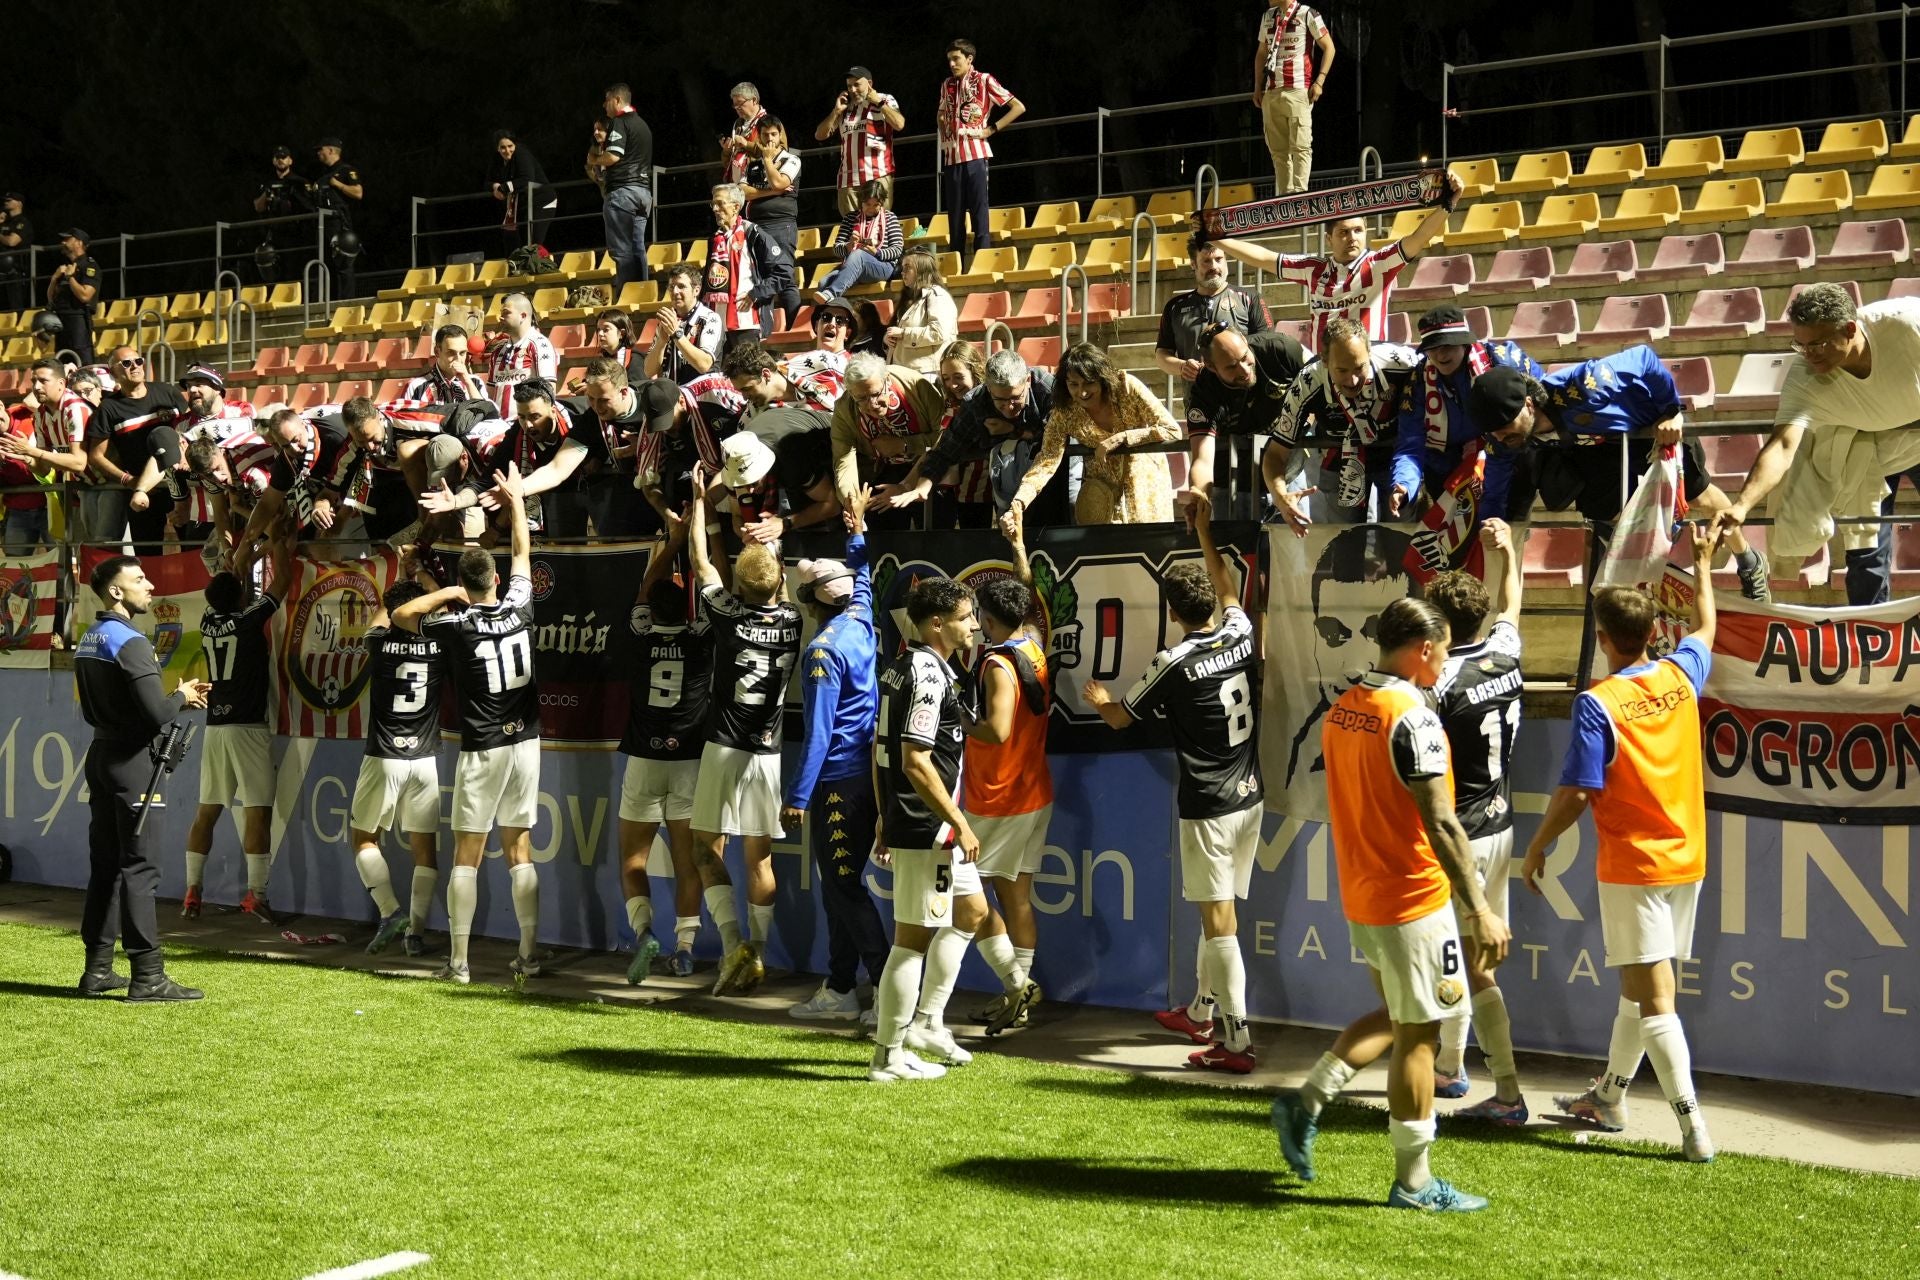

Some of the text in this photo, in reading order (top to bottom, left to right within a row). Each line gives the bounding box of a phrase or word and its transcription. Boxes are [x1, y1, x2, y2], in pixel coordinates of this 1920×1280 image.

[1221, 179, 1421, 231] LOGROENFERMOS
[477, 613, 521, 634] ÁLVARO
[533, 610, 611, 654] oñés
[736, 624, 799, 643] SERGIO GIL
[202, 635, 238, 681] 17
[382, 641, 426, 656] NACHO
[474, 630, 531, 693] 10
[650, 643, 685, 659] RAÚL
[393, 662, 428, 712] 3
[648, 660, 684, 708] 9
[734, 649, 796, 706] 21
[1466, 668, 1523, 704] BASURTO
[538, 693, 579, 707] OCIOS
[1219, 672, 1254, 747] 8
[1620, 685, 1690, 721] Kappa
[1480, 698, 1521, 782] 11
[935, 864, 949, 893] 5
[1442, 940, 1459, 976] 6
[1824, 969, 1907, 1015] SL
